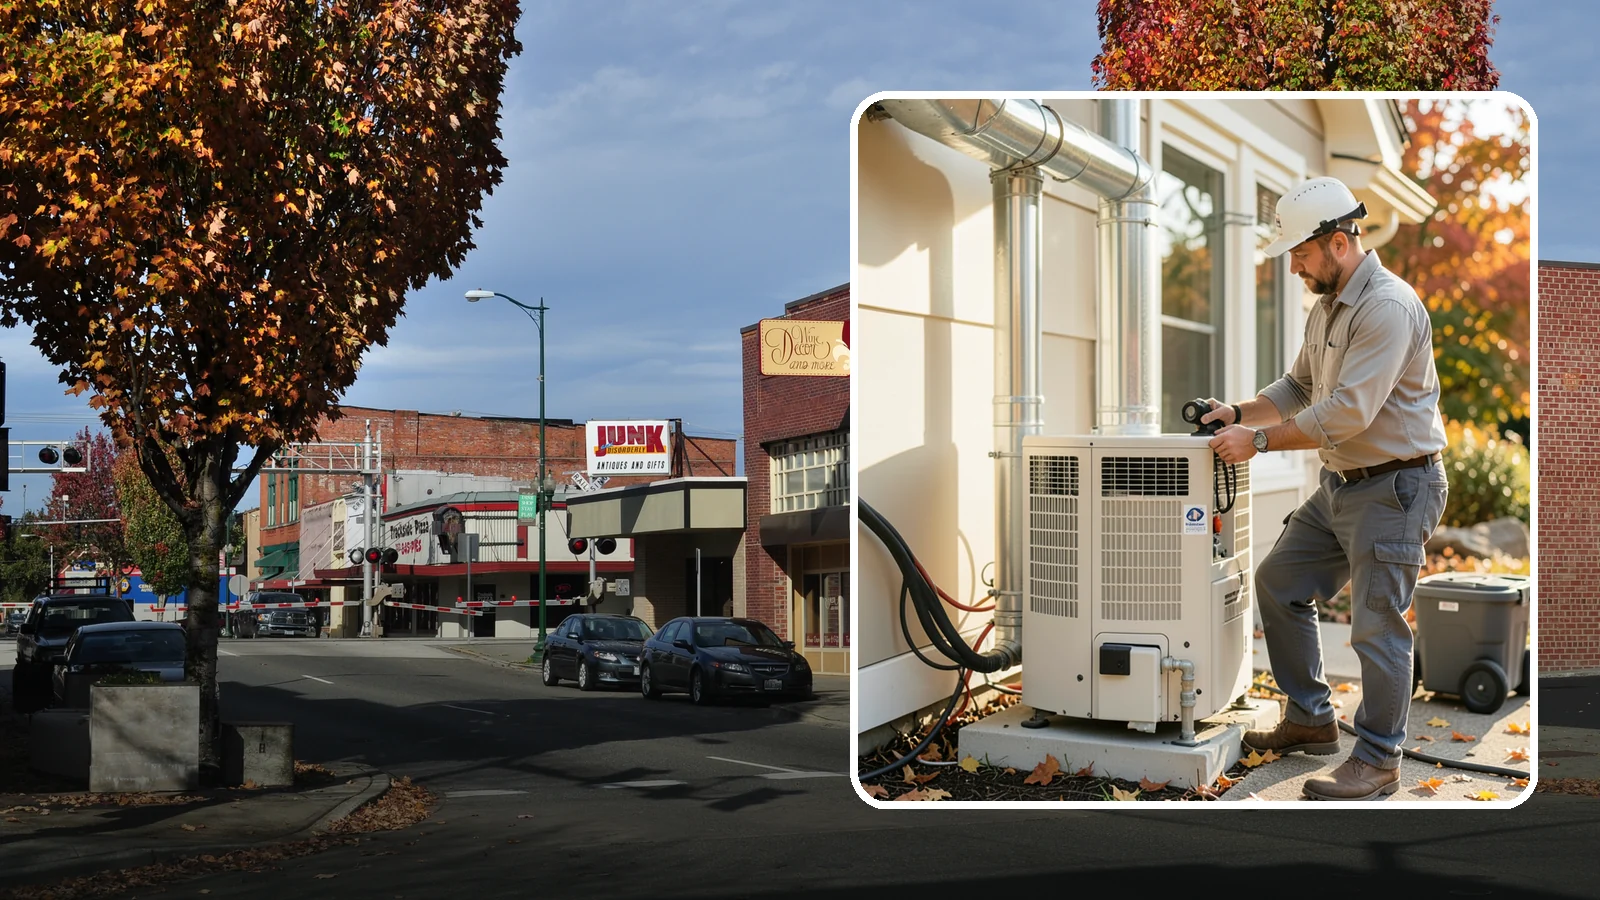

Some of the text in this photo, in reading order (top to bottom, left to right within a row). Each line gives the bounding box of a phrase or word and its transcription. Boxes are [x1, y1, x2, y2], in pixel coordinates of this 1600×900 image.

[596, 425, 666, 457] JUNK
[608, 446, 646, 454] DISORDERLY
[597, 461, 665, 470] ANTIQUES AND GIFTS
[390, 519, 429, 539] Trackside Pizza
